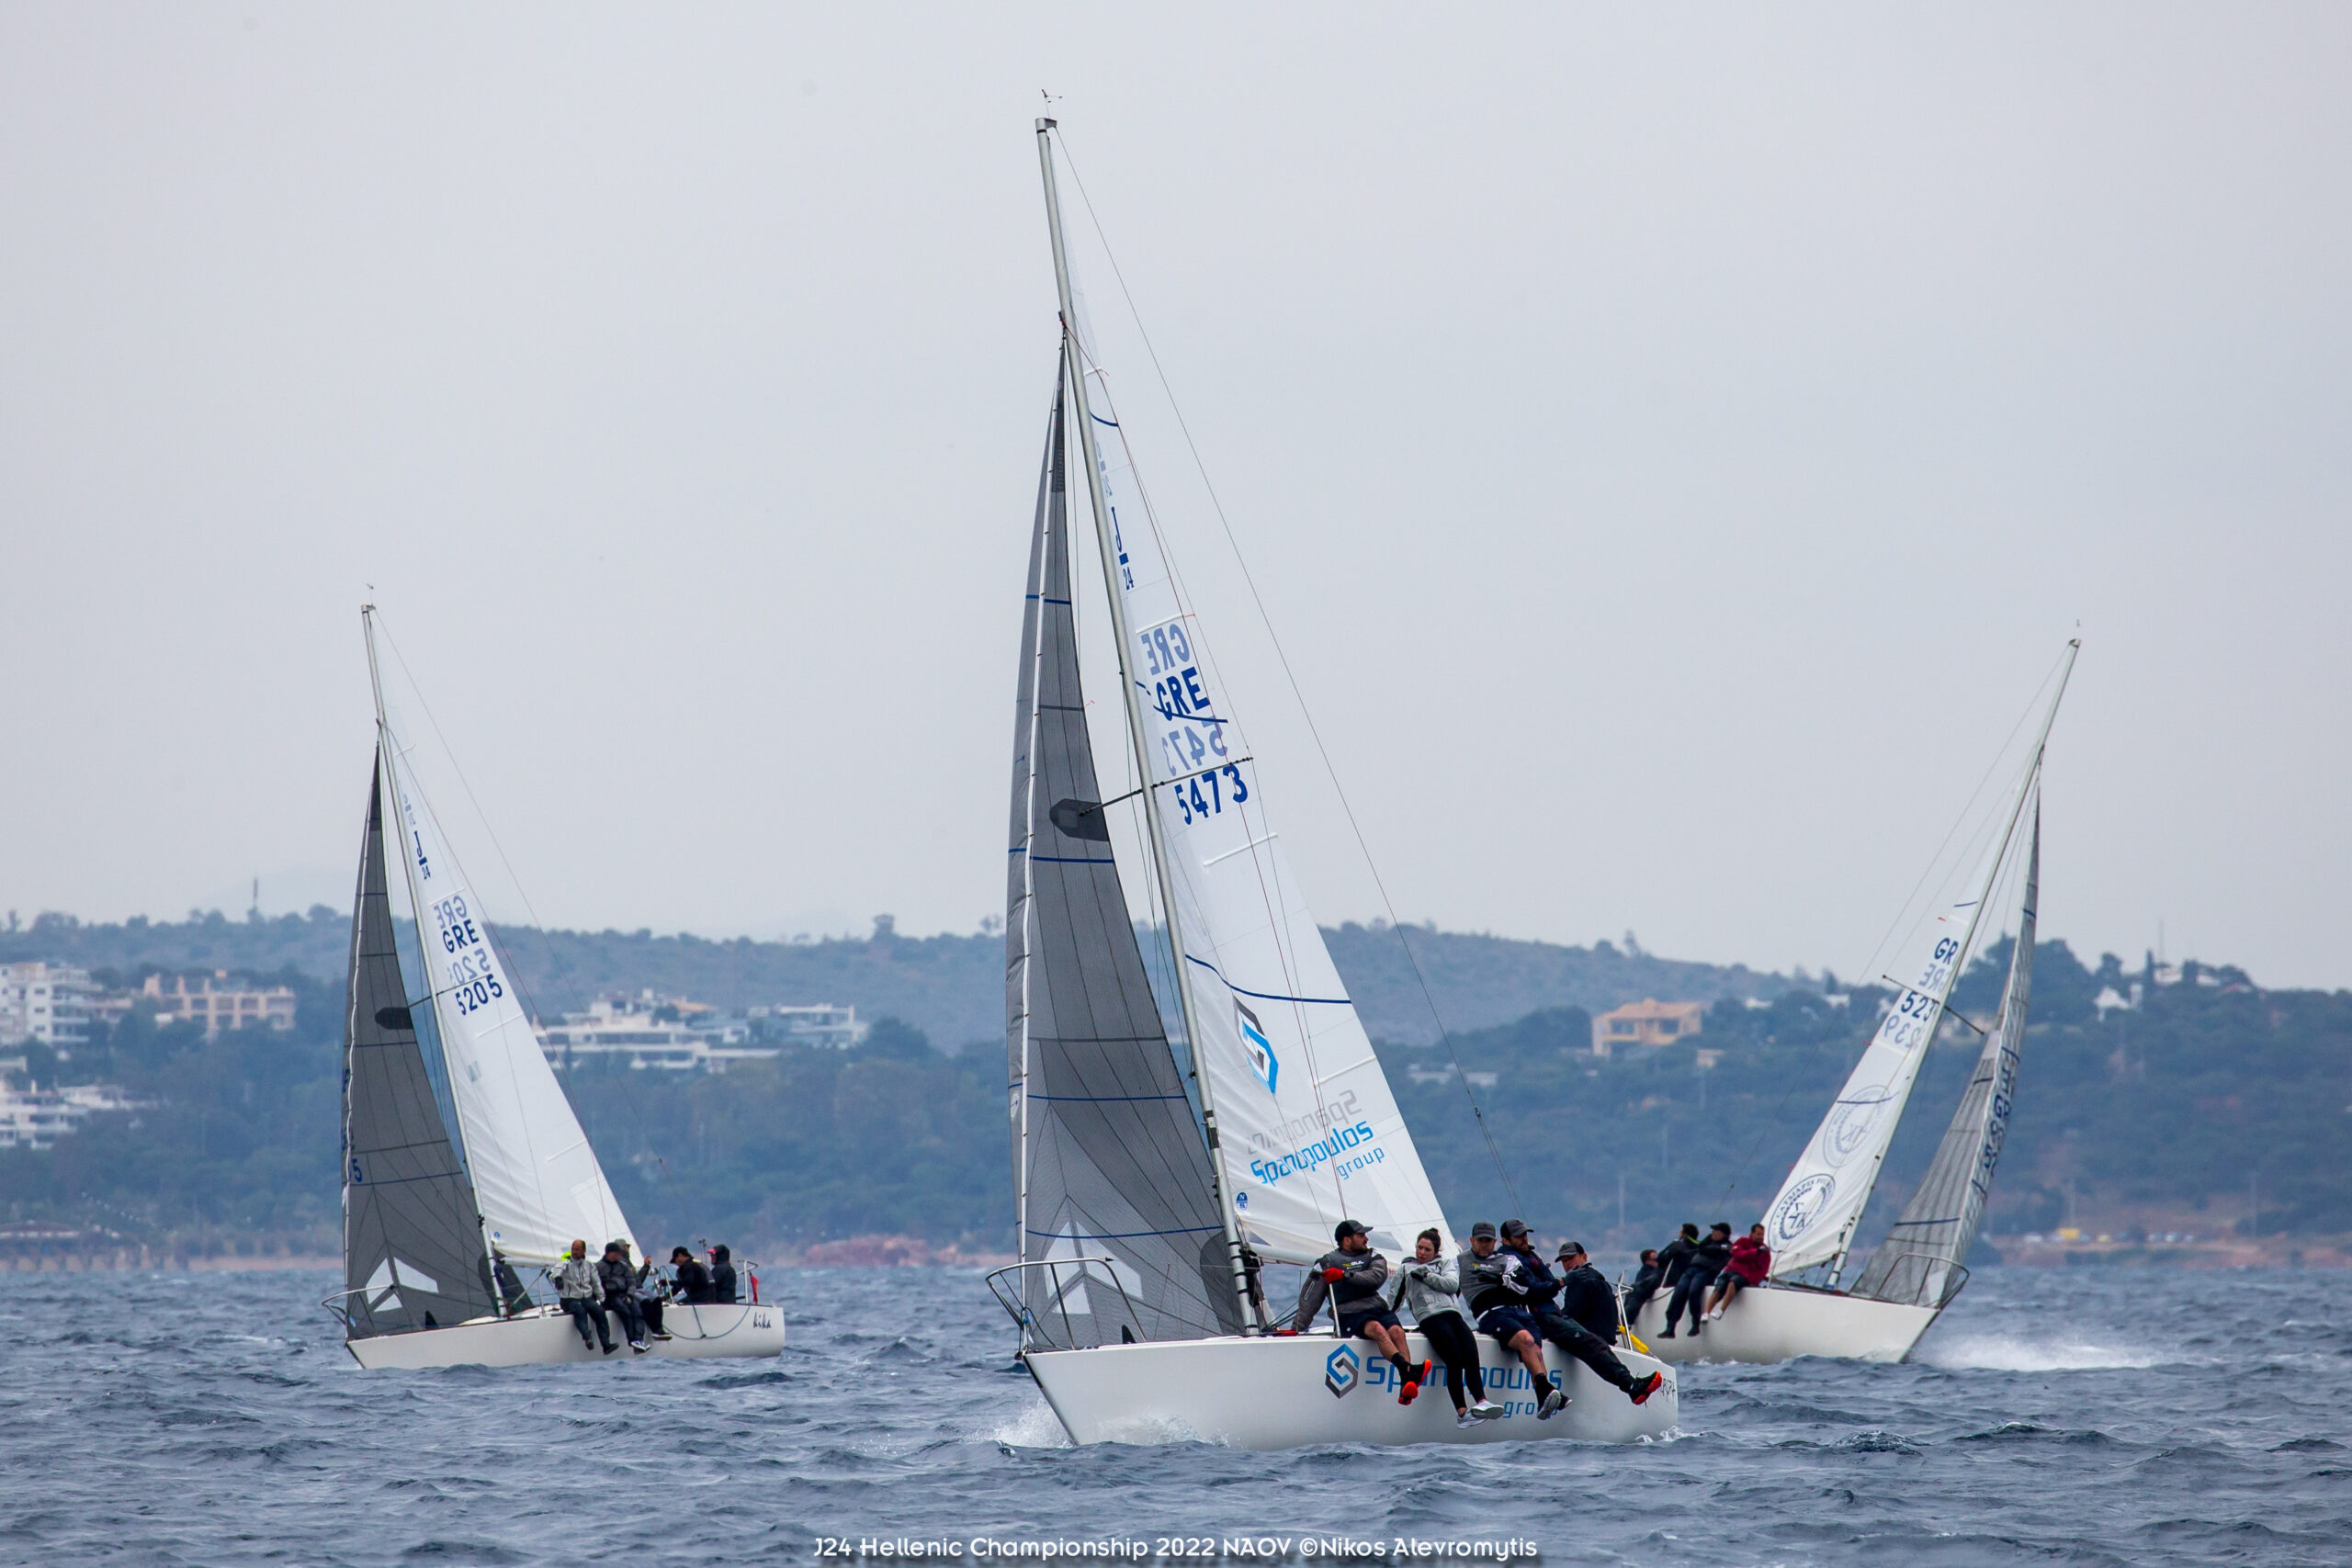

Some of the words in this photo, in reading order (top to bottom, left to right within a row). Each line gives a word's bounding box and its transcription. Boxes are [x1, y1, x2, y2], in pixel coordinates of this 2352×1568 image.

[1156, 666, 1211, 721] GRE
[1174, 763, 1249, 825] 5473
[443, 919, 480, 953] GRE
[1934, 937, 1959, 964] GR
[456, 974, 503, 1016] 5205
[1901, 990, 1937, 1022] 523
[1250, 1120, 1374, 1187] Spanopoulos
[1337, 1146, 1385, 1180] group
